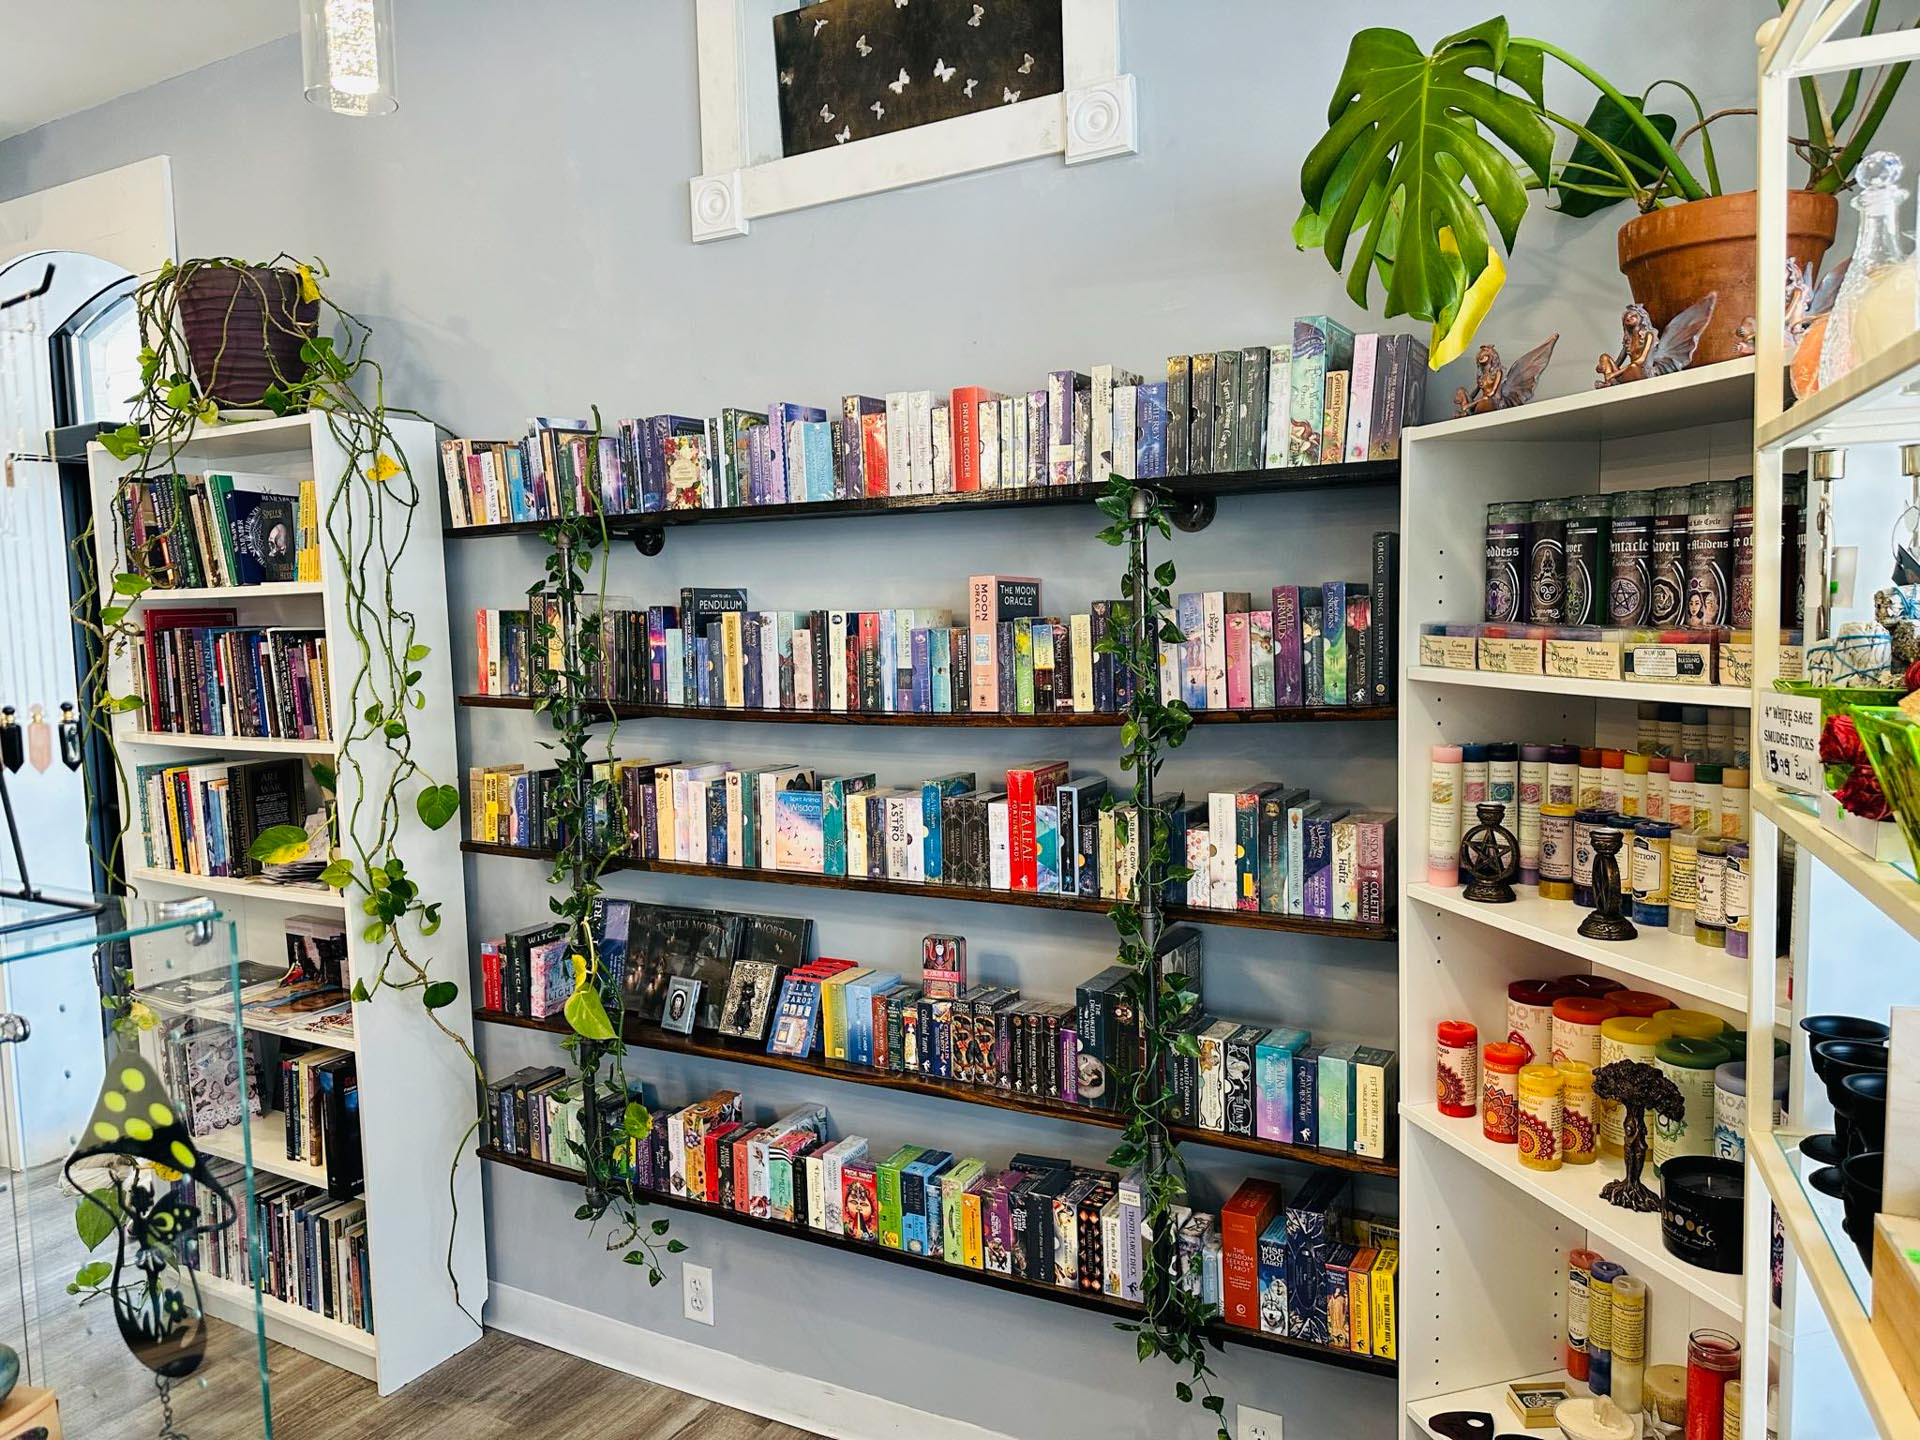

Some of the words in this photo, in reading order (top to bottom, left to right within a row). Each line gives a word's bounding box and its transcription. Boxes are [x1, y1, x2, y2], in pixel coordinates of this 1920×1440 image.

[1333, 373, 1342, 406] GARDEN
[1309, 390, 1319, 420] Wisdom
[1331, 407, 1339, 441] DRAGONS
[963, 436, 971, 479] DECODER
[1694, 539, 1729, 550] Maidens
[1377, 541, 1385, 574] ORIGINS
[1000, 584, 1013, 595] THE
[1015, 586, 1036, 596] MOON
[699, 600, 743, 609] PENDULUM
[1004, 596, 1033, 606] ORACLE
[1327, 592, 1335, 629] UNICORNS
[1277, 593, 1287, 640] MERMAIDS
[1586, 646, 1609, 656] Miracles
[1678, 656, 1700, 665] BLESSING
[1783, 652, 1799, 661] Spell
[1684, 663, 1694, 671] KITS
[1773, 706, 1793, 722] WHITE
[1793, 710, 1813, 726] SAGE
[1763, 729, 1790, 746] SMUDGE
[1790, 734, 1815, 751] STICKS
[789, 803, 821, 812] Wisdom
[1021, 800, 1031, 826] TEA
[891, 802, 899, 842] ASTRO
[1022, 830, 1033, 862] LEAF
[1370, 827, 1378, 864] WISDOM
[1339, 858, 1347, 884] Hafiz
[1370, 881, 1379, 921] COLETTE
[759, 922, 798, 943] MORTEM
[786, 995, 813, 1005] TAROT
[1370, 1077, 1378, 1097] FIFTH
[1266, 1087, 1274, 1121] Valentine
[532, 1109, 540, 1140] GOOD
[1369, 1124, 1378, 1148] TAROT
[1226, 1252, 1254, 1262] WISDOM
[1232, 1246, 1245, 1255] THE
[1260, 1245, 1284, 1256] WISP
[1261, 1252, 1284, 1263] DOG
[1229, 1264, 1251, 1273] TAROT
[1262, 1259, 1284, 1268] TAROT
[1355, 1277, 1364, 1303] Radiant
